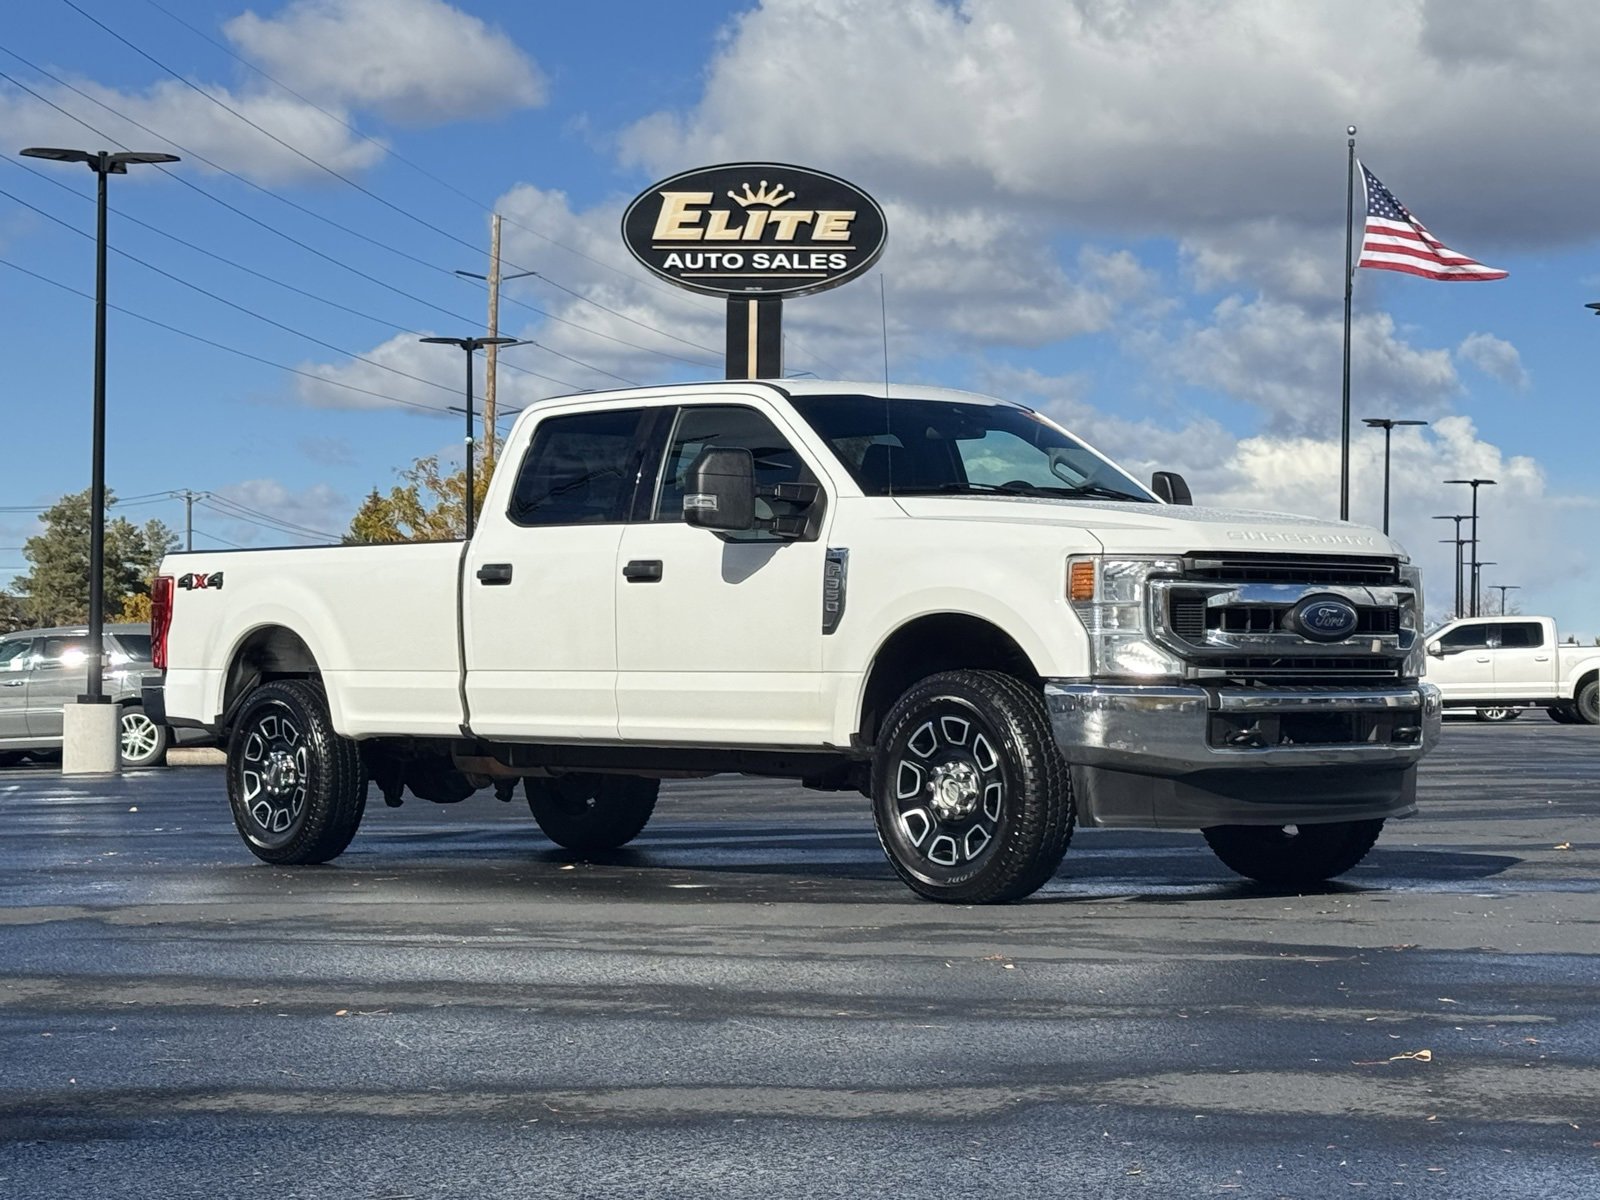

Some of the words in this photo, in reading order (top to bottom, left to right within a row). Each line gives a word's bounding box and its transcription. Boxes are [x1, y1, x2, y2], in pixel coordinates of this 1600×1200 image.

[652, 191, 856, 241] ELITE
[663, 252, 744, 269] AUTO
[752, 253, 847, 270] SALES
[1315, 607, 1346, 627] Ford
